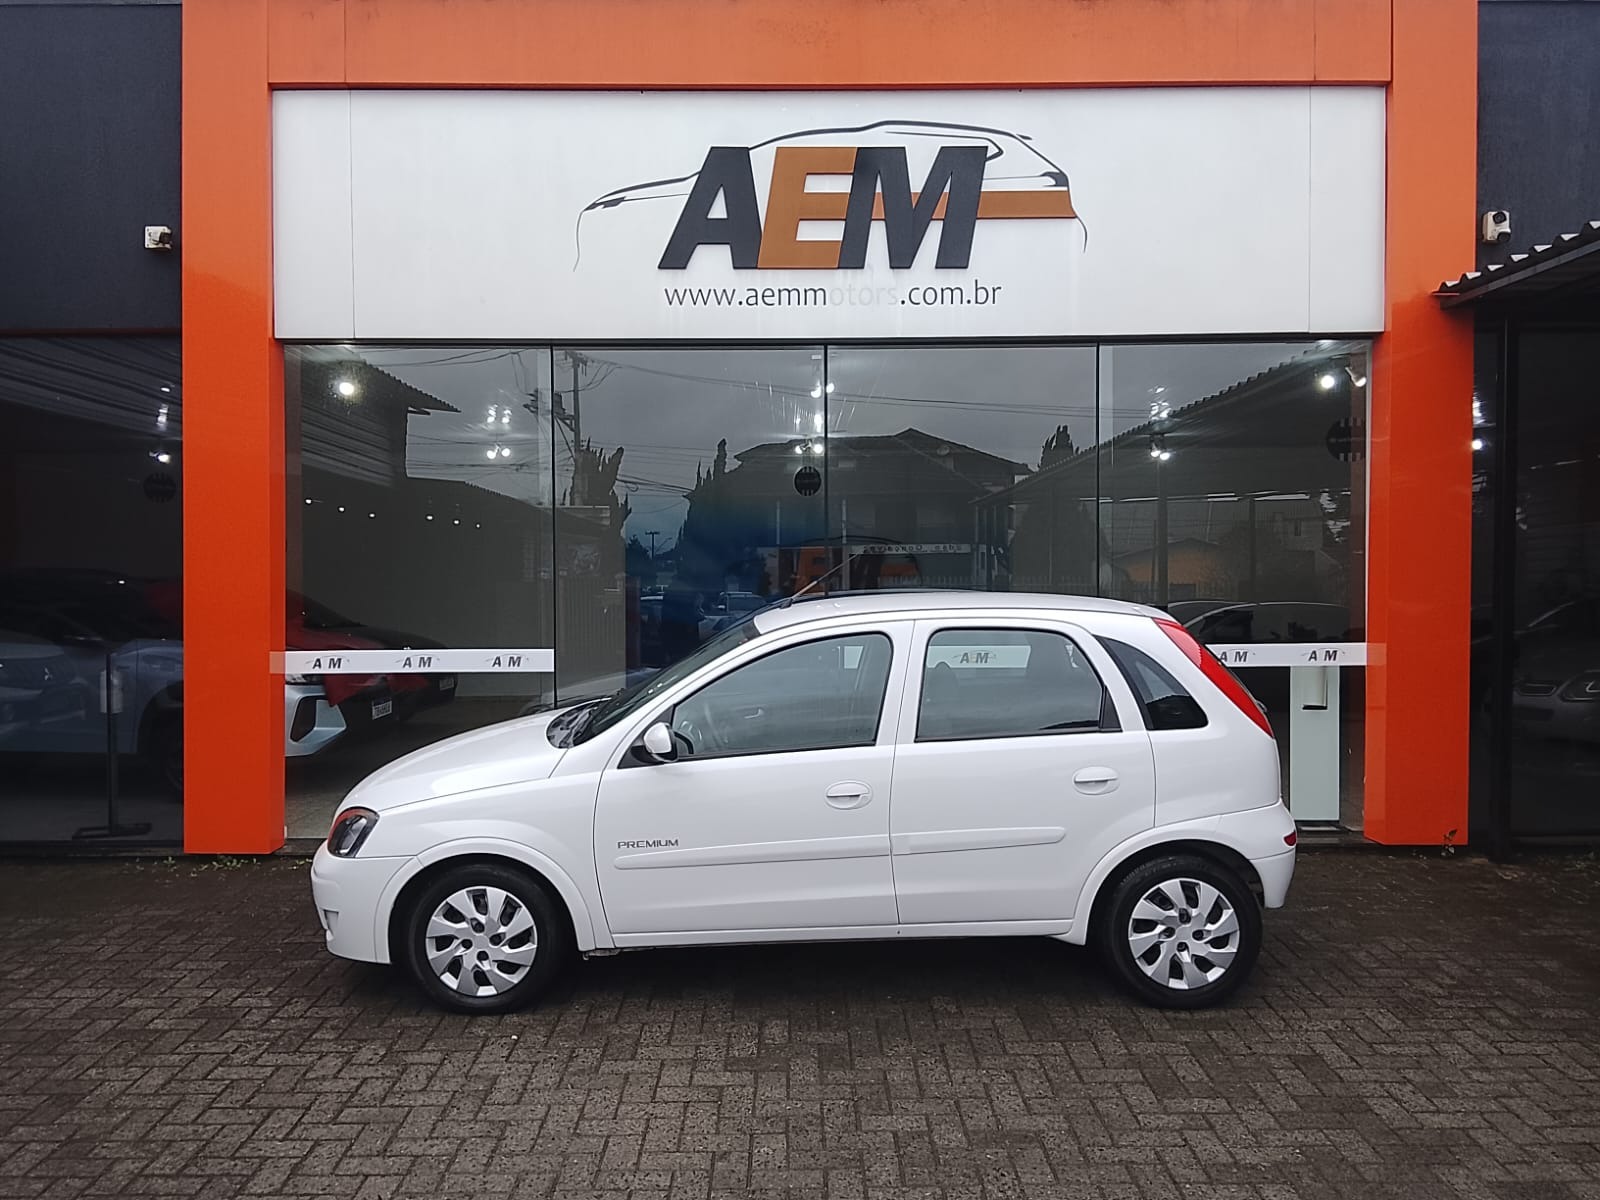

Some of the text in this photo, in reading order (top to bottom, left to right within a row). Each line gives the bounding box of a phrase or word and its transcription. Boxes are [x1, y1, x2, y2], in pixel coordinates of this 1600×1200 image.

[657, 145, 989, 270] AEM
[664, 278, 1002, 307] www.aemmotors.com.br
[617, 838, 679, 849] PREMIUM
